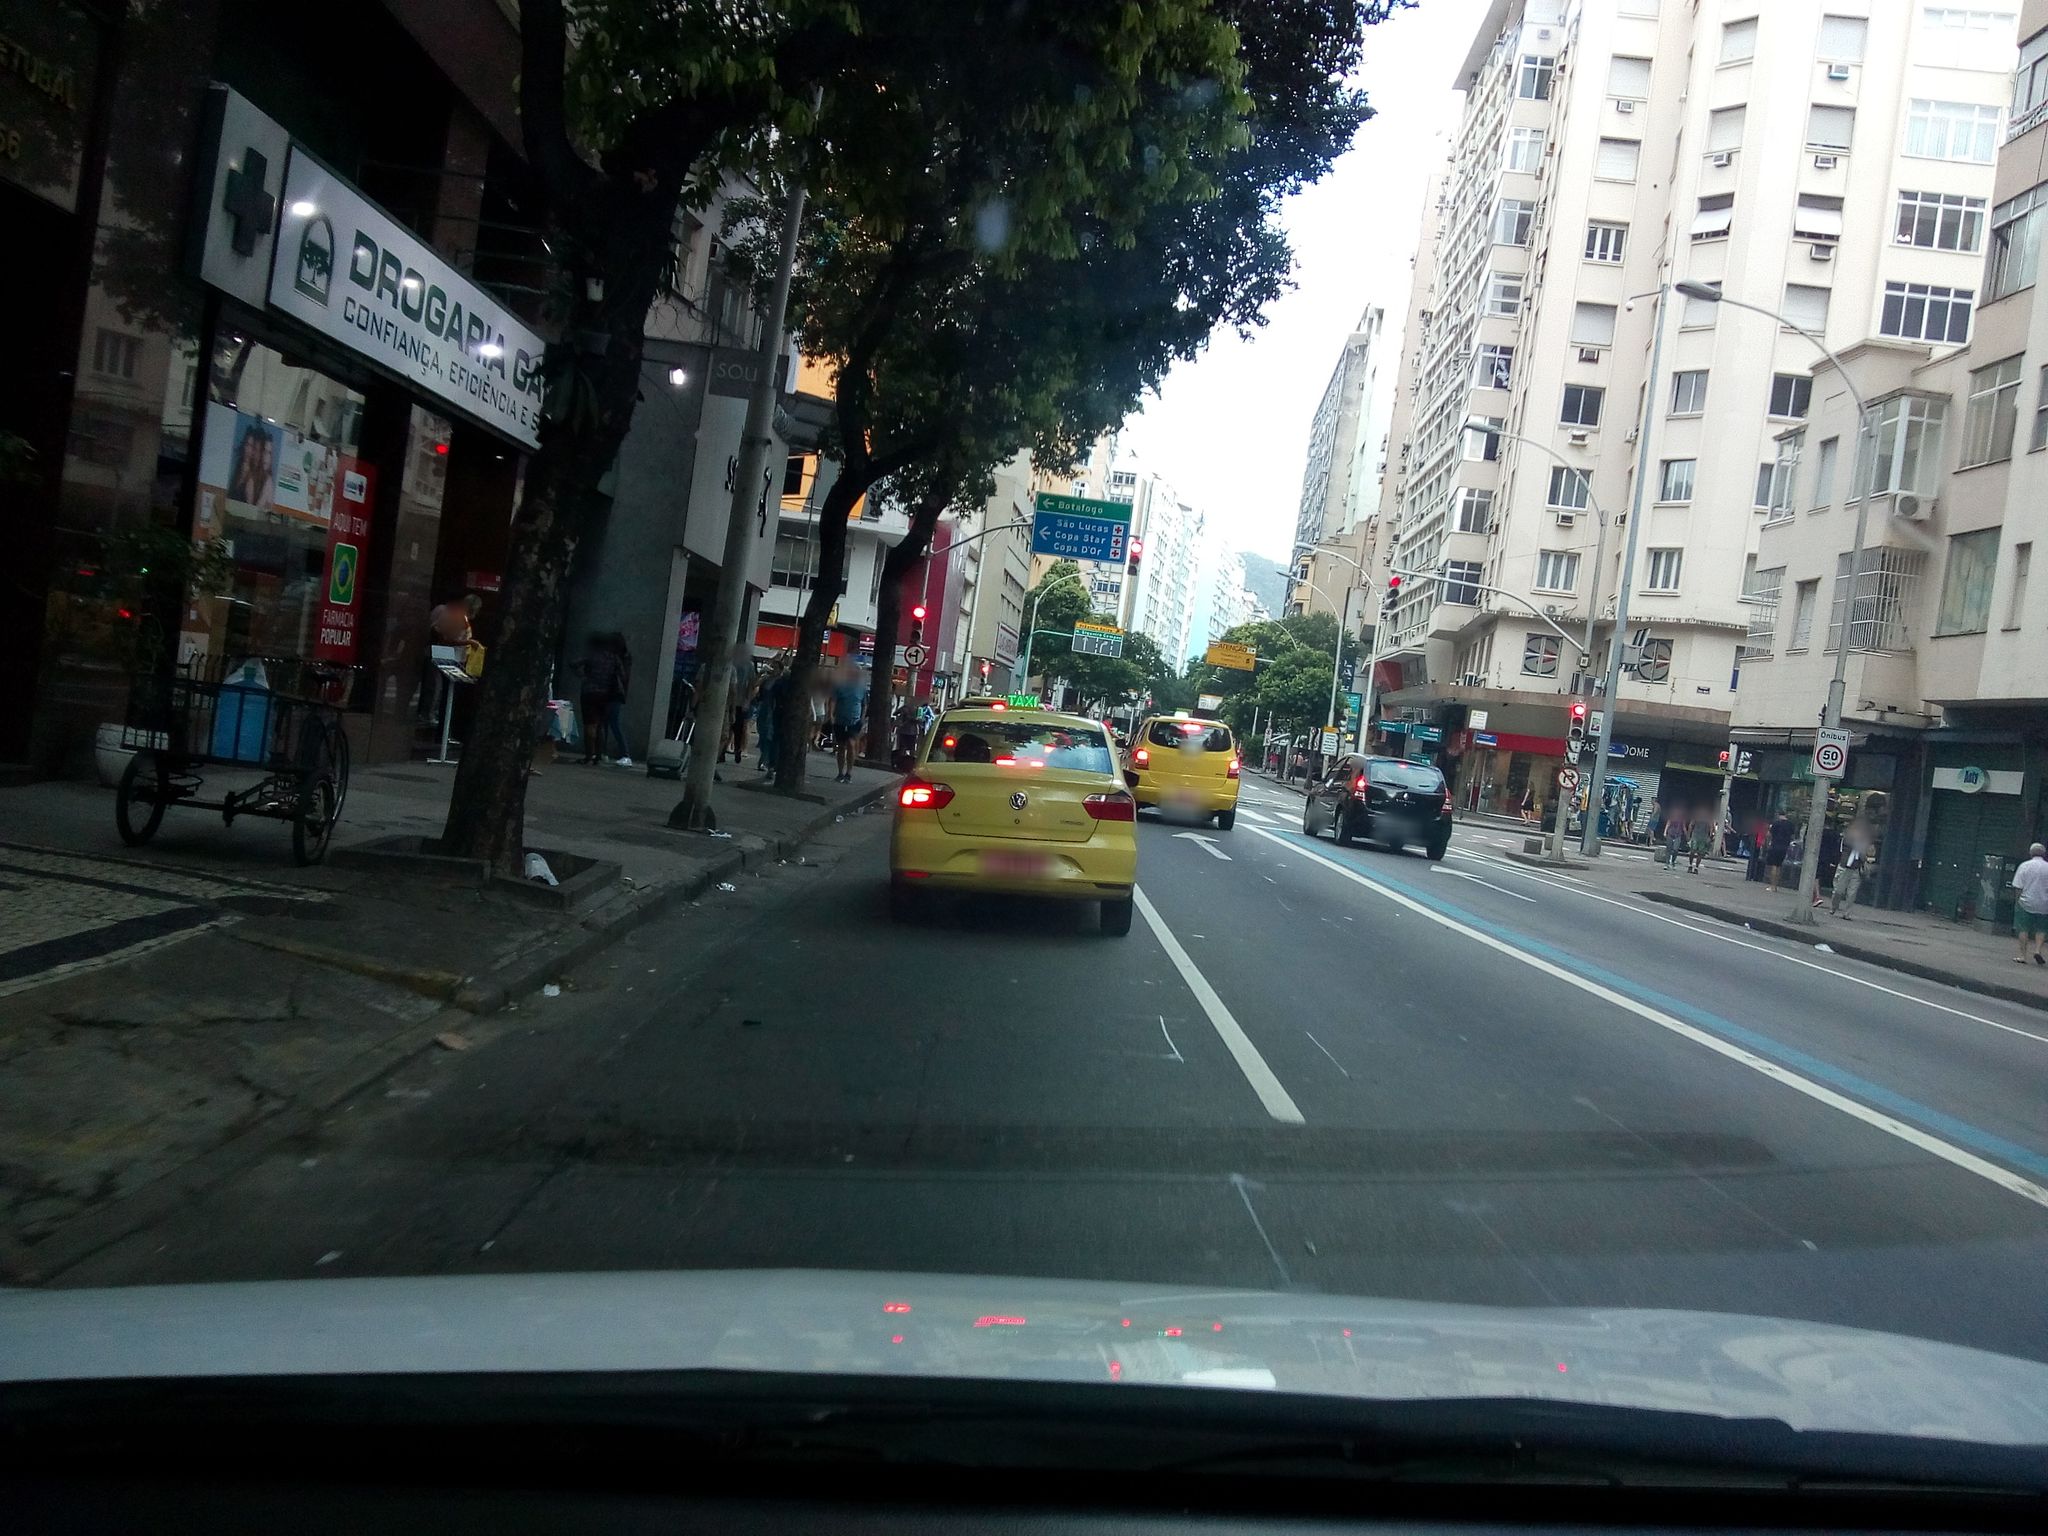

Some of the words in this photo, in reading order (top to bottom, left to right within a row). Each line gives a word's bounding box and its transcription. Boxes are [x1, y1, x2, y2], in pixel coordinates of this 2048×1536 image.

[349, 228, 505, 380] DROGARIA
[513, 348, 543, 404] GA
[521, 406, 529, 425] E
[1058, 501, 1103, 515] Botafogo
[1056, 518, 1074, 528] São
[1078, 521, 1109, 534] Lucas
[1055, 531, 1079, 543] Copa
[1083, 534, 1107, 545] Star
[1053, 542, 1078, 553] Copa
[1081, 545, 1103, 556] D'Or
[320, 628, 351, 646] POPULAR
[1008, 695, 1039, 707] TAXI
[1823, 750, 1838, 761] 50
